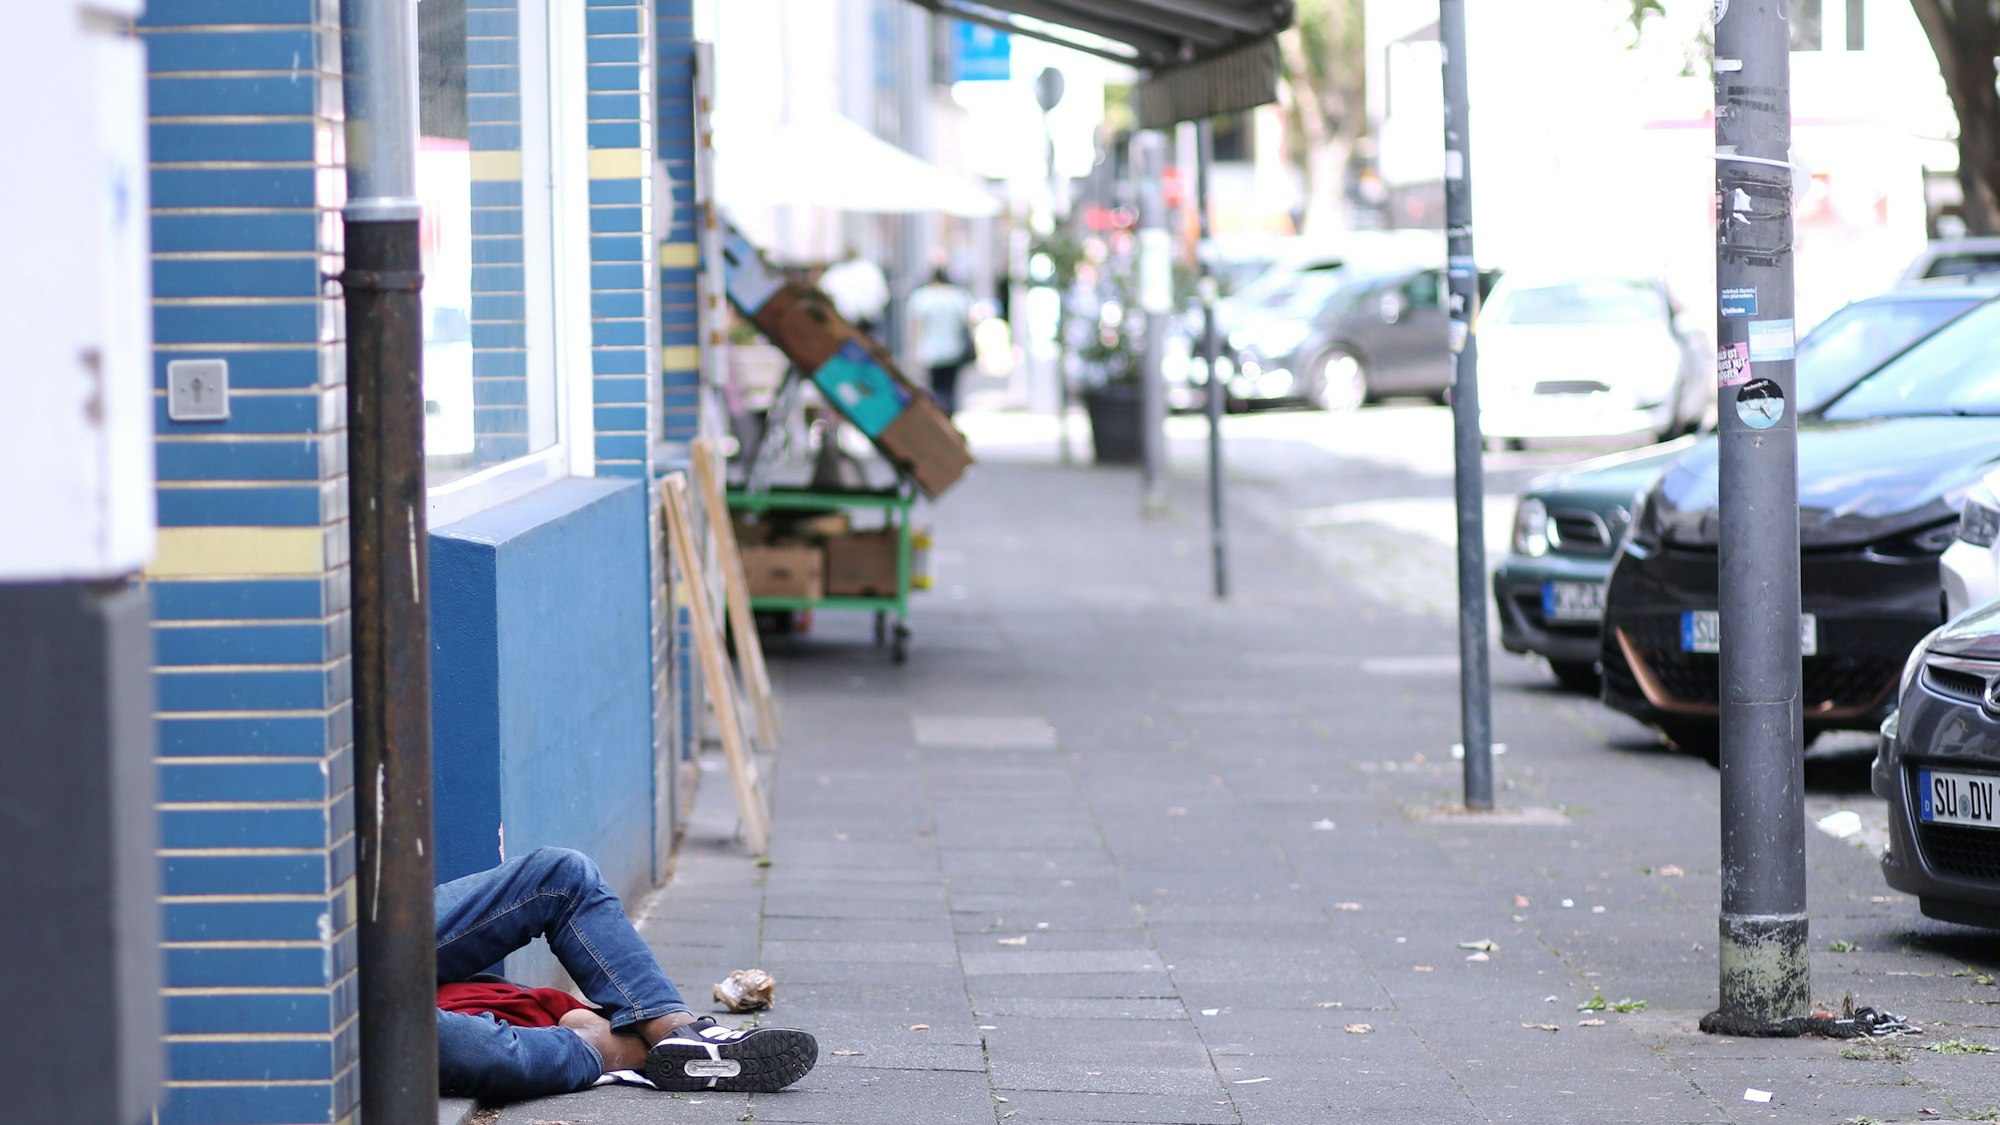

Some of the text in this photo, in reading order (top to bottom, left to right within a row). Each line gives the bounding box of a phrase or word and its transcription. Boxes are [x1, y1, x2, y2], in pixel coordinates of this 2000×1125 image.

[1695, 617, 1718, 644] SU
[1935, 777, 1958, 817] SU
[1969, 781, 1993, 821] DV
